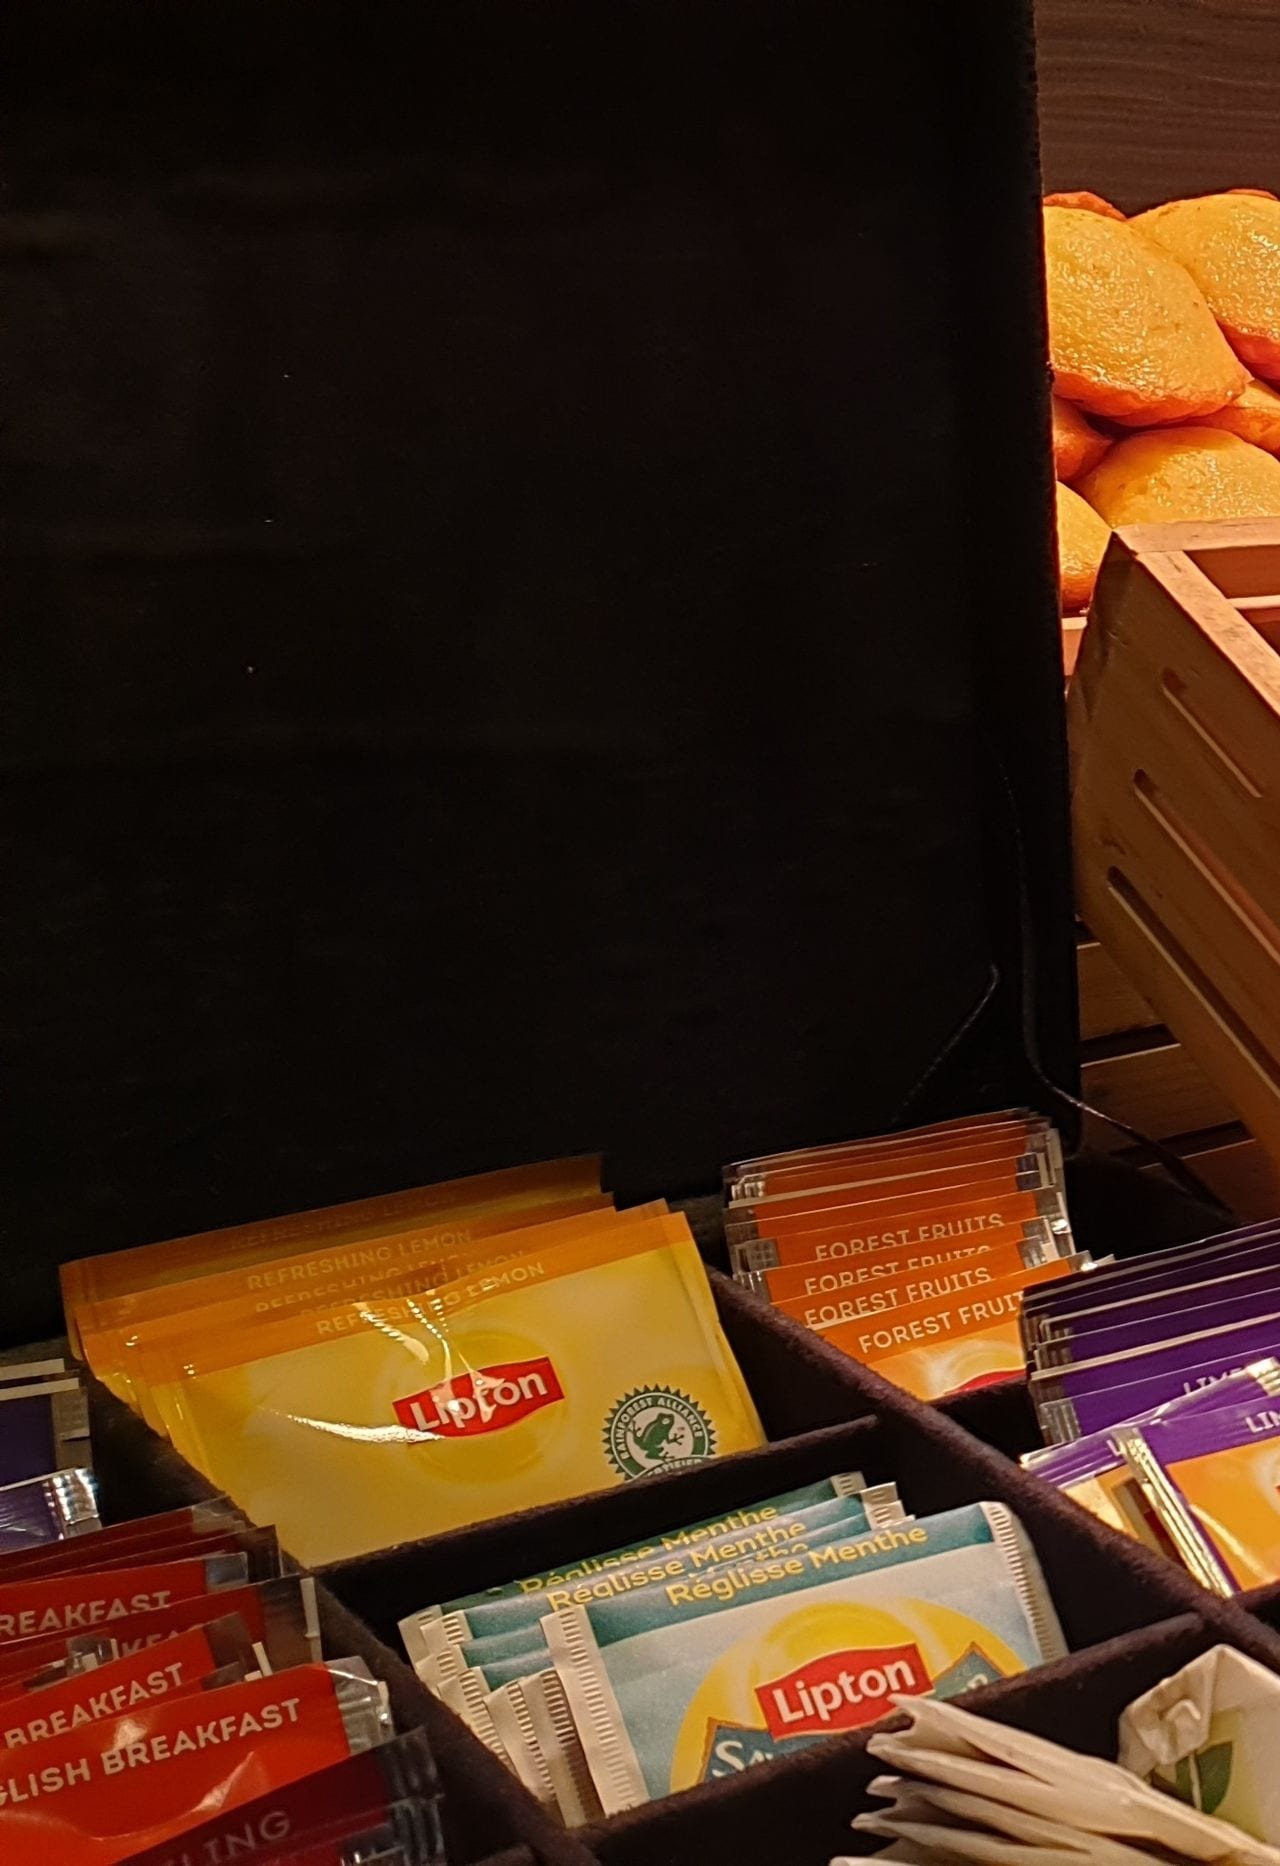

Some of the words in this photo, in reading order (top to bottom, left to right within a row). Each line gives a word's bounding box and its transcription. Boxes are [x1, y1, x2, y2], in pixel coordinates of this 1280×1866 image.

[247, 1244, 393, 1291] REFRESHING
[398, 1228, 474, 1256] LEMON
[814, 1229, 911, 1263] FOREST
[466, 1261, 546, 1298] LEMON
[803, 1288, 899, 1326] FOREST
[905, 1266, 993, 1305] FRUITS
[857, 1311, 953, 1354] FOREST
[957, 1289, 1025, 1326] FRUIT
[409, 1371, 548, 1432] Lipton
[665, 1555, 807, 1608] Réglisse
[809, 1526, 929, 1573] Menthe
[689, 1519, 807, 1567] Menthe
[0, 1590, 172, 1638] REAKFAST
[771, 1659, 917, 1724] Lipton
[98, 1697, 302, 1777] BREAKFAST
